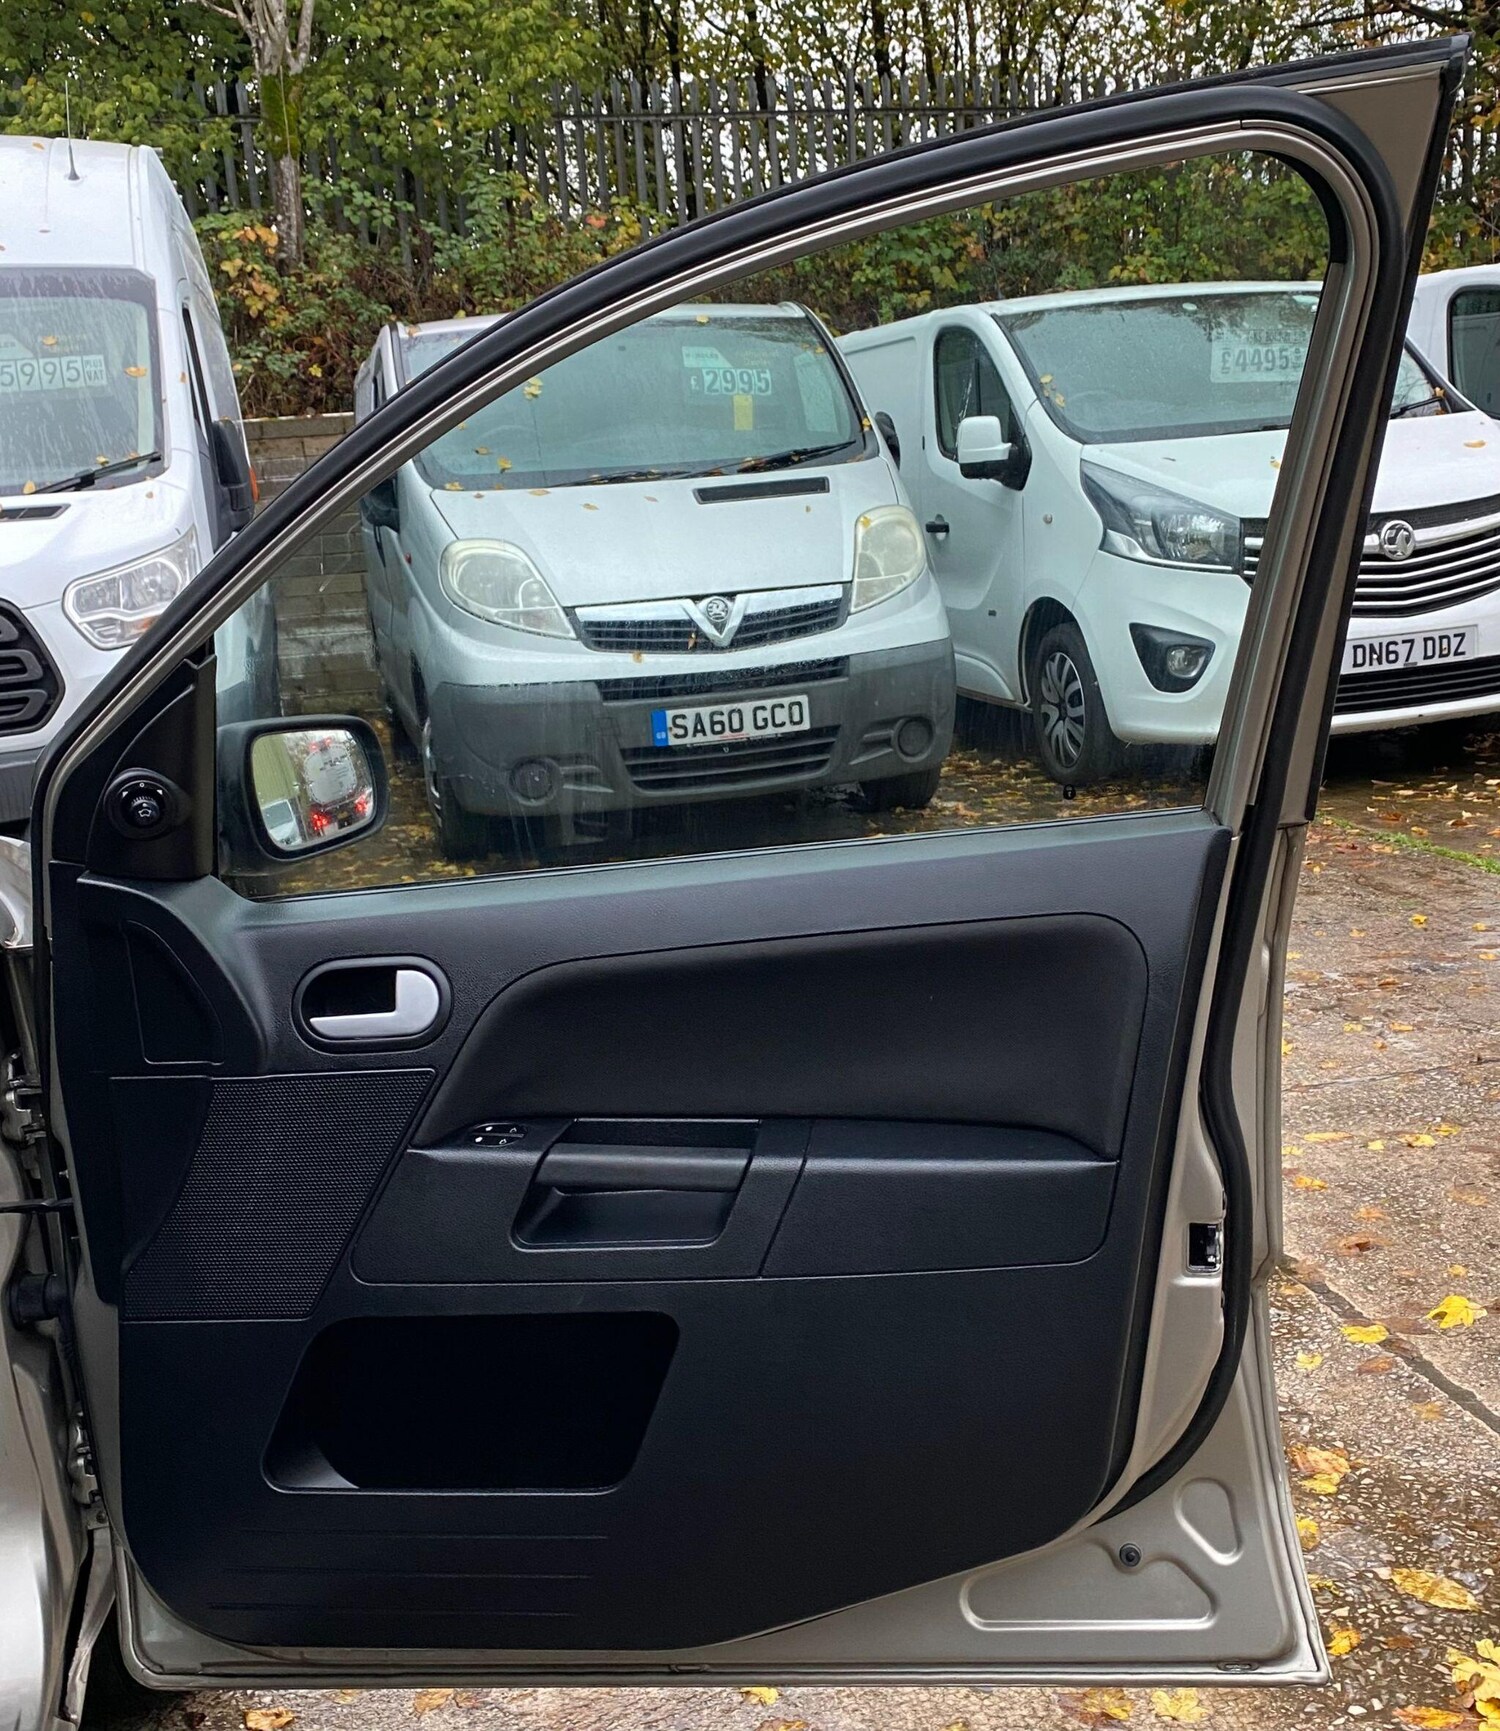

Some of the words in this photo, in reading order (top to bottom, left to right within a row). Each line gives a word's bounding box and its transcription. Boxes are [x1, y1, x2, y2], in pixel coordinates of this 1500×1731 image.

[0, 360, 80, 387] 5995
[86, 370, 104, 381] VAT
[1352, 638, 1415, 668] DN67
[1423, 632, 1466, 661] DDZ
[671, 708, 744, 739] SA60
[752, 701, 804, 731] GCO
